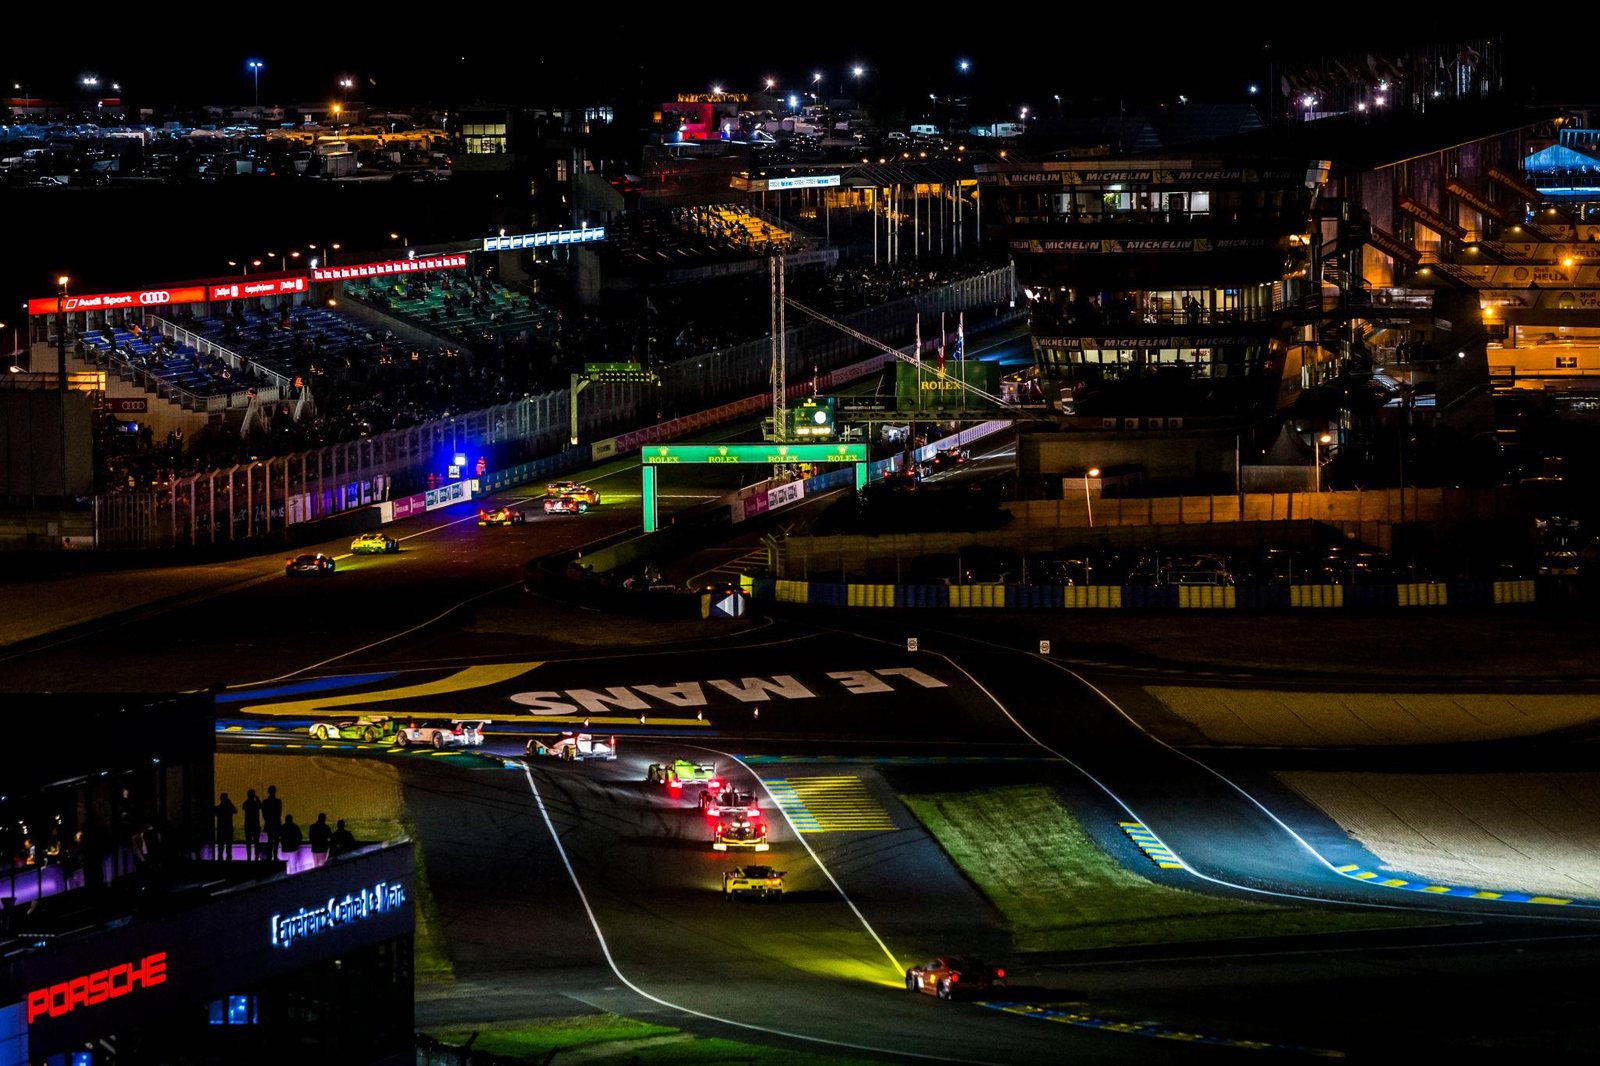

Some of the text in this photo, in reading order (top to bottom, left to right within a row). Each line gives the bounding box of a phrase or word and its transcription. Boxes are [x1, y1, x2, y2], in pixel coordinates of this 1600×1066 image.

[1011, 173, 1060, 182] MICHELIN
[1086, 172, 1150, 181] MICHELIN
[1178, 171, 1240, 180] MICHELIN
[1045, 241, 1099, 249] MICHELIN
[1127, 241, 1193, 249] MICHELIN
[78, 295, 132, 307] Audi Sport
[1039, 338, 1079, 347] MICHELIN
[1103, 338, 1168, 347] MICHELIN
[921, 381, 961, 390] ROLEX
[509, 667, 949, 716] LE MANS
[27, 952, 167, 1025] PORSCHE
